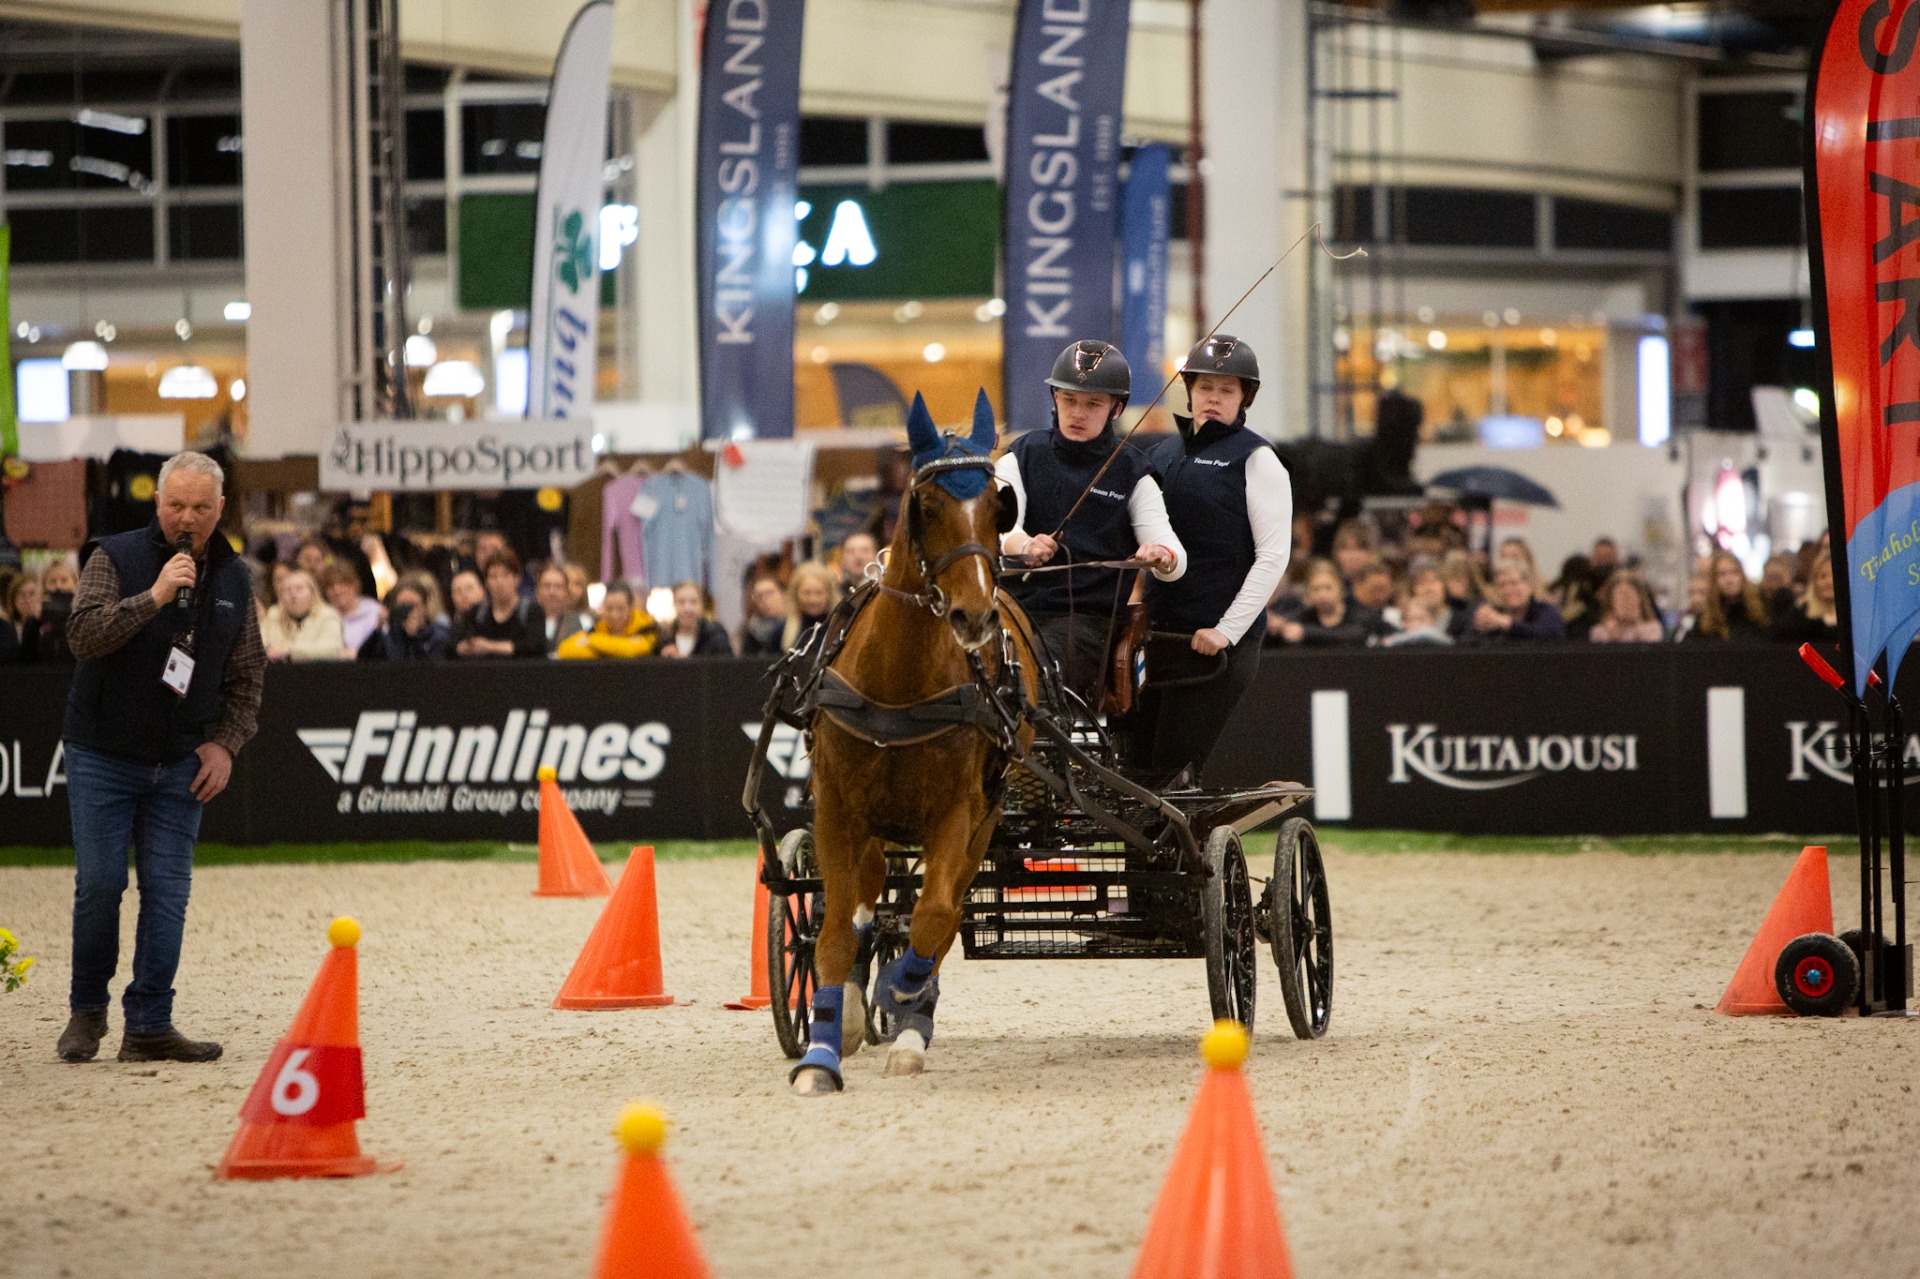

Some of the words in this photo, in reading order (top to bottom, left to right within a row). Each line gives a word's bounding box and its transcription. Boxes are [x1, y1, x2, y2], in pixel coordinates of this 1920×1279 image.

[715, 0, 769, 345] KINGSLAND
[1025, 0, 1090, 338] KINGSLAND
[352, 434, 584, 485] HippoSport
[1193, 457, 1213, 465] Team
[341, 708, 671, 784] Finnlines
[1385, 722, 1639, 790] KULTAJOUSI
[1784, 720, 1920, 786] KUA
[337, 790, 353, 813] a
[357, 785, 449, 814] Grimaldi
[452, 785, 518, 817] Group
[521, 787, 621, 816] cpany
[271, 1049, 319, 1116] 6
